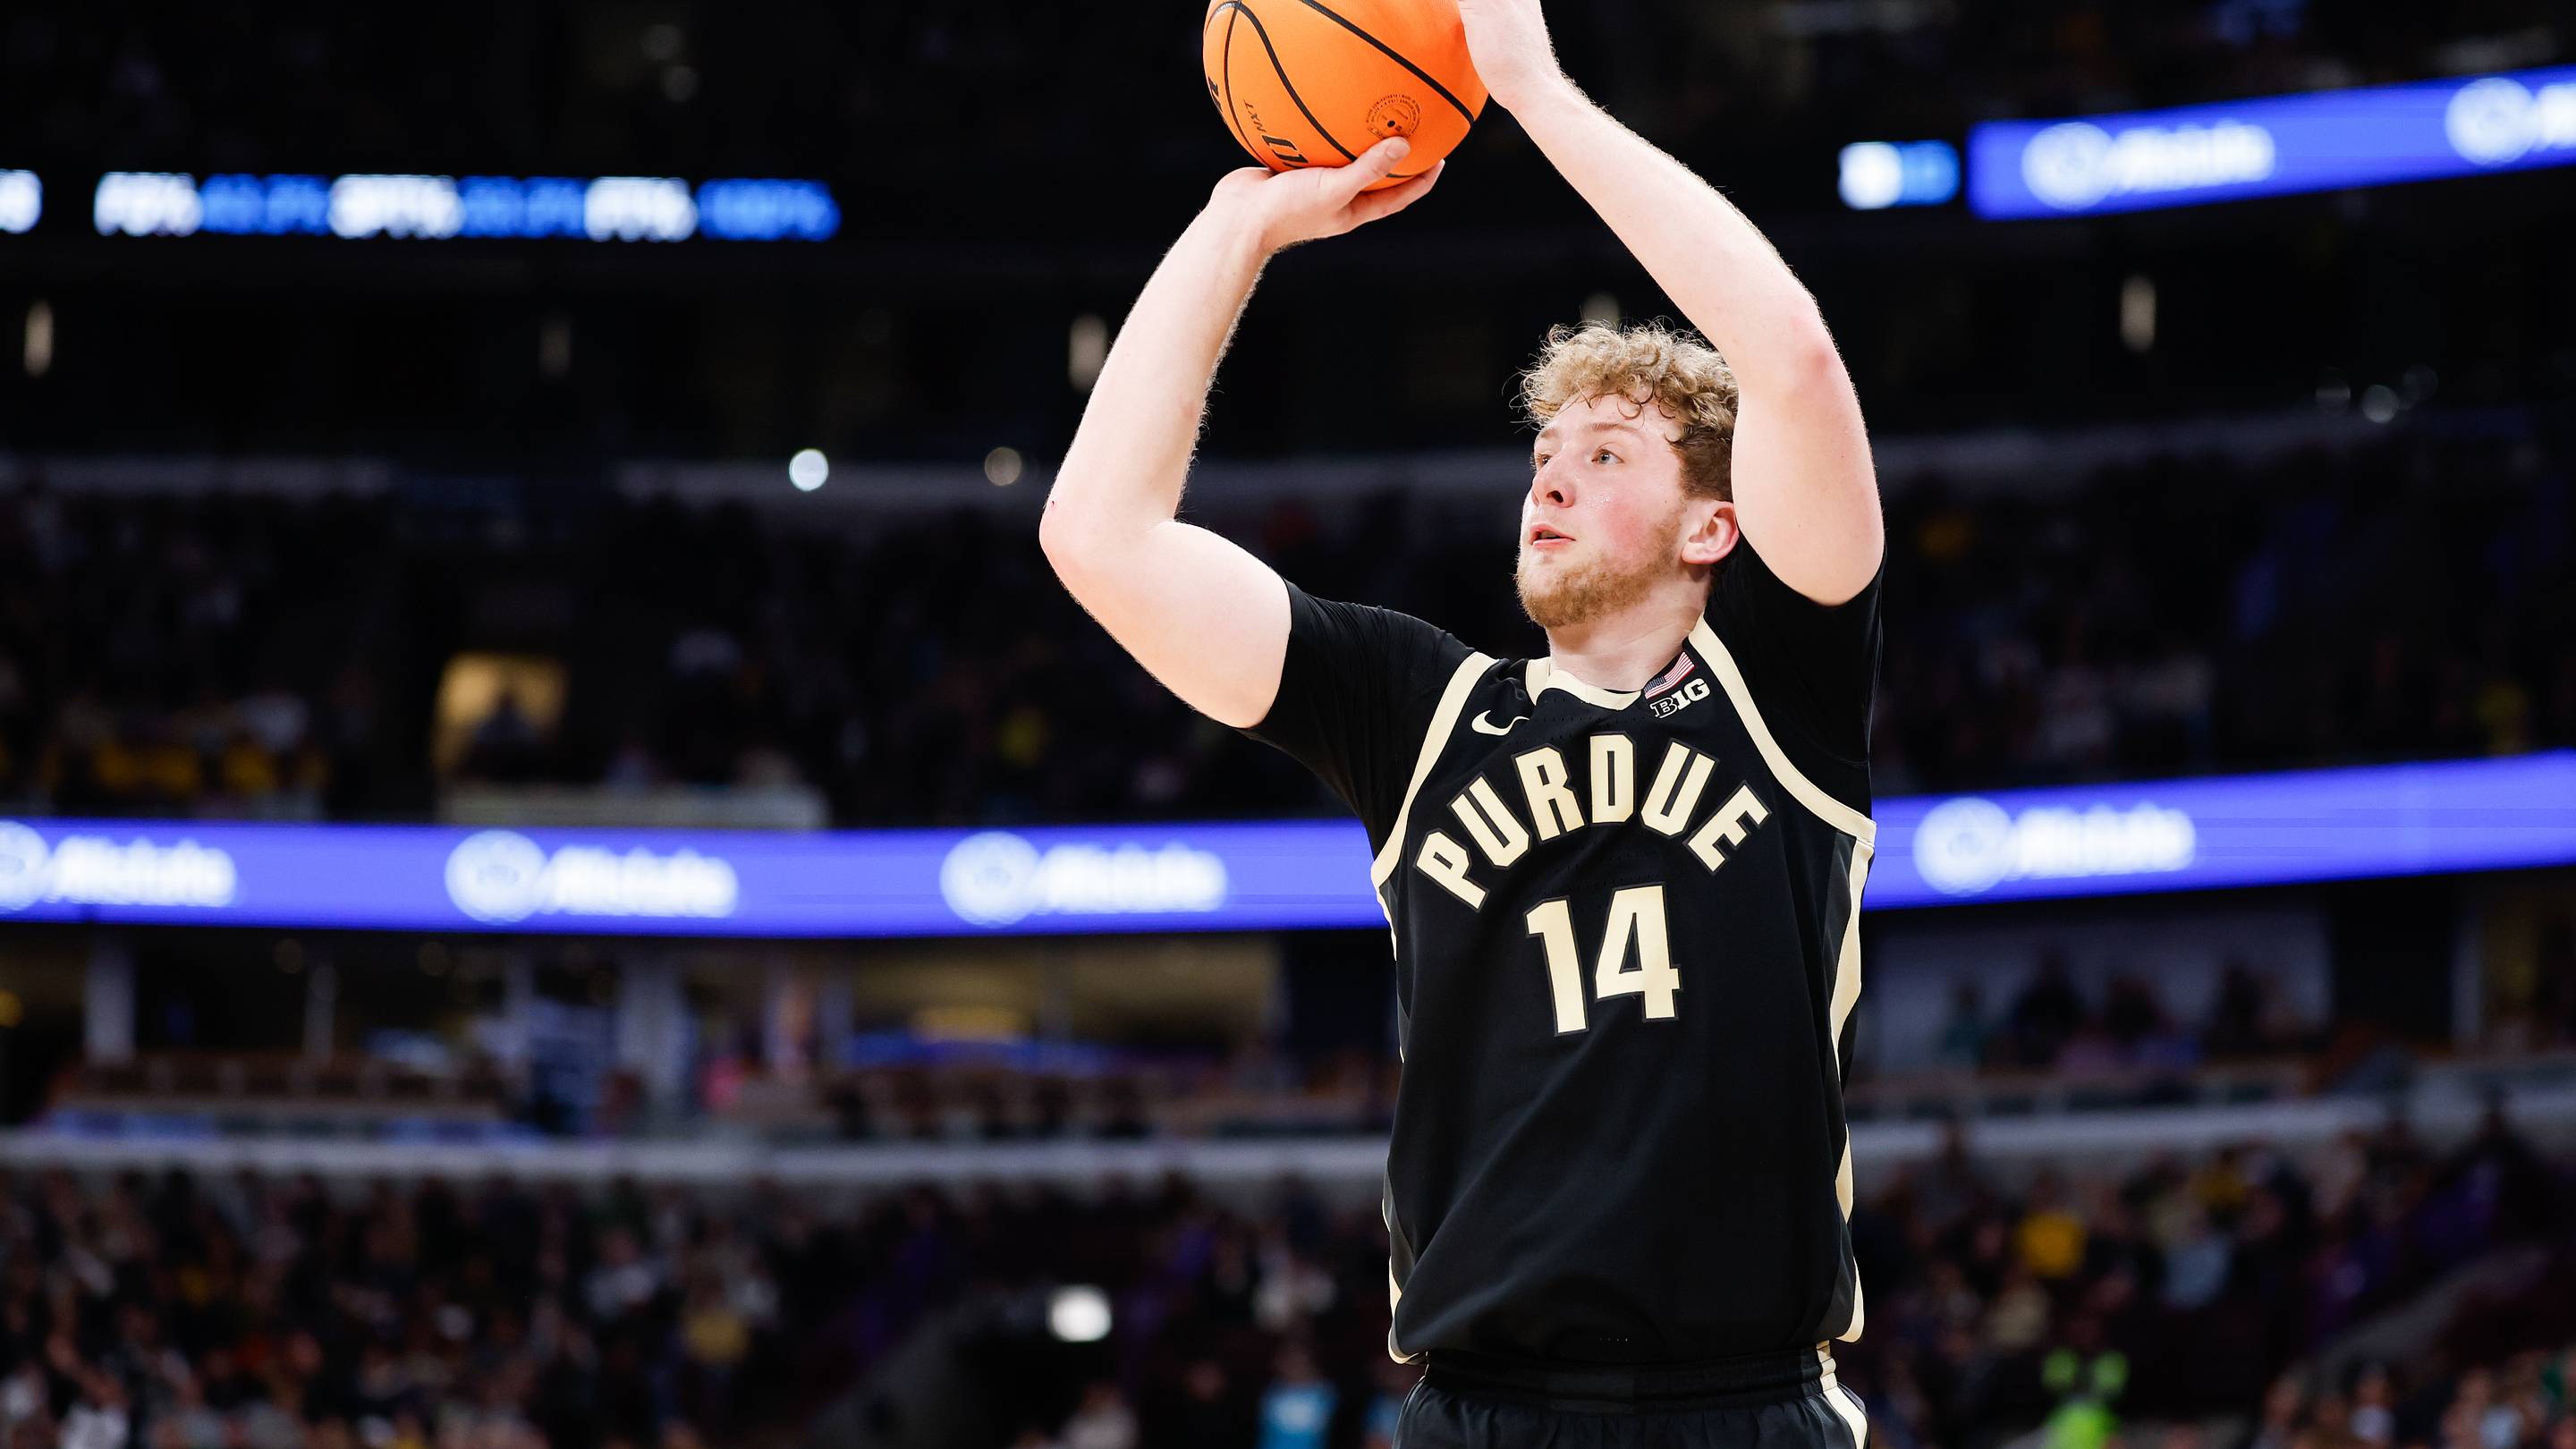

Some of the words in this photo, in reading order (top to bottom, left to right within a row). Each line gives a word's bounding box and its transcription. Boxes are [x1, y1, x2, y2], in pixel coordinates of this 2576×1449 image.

[1243, 99, 1267, 133] NXT
[1413, 730, 1772, 912] PURDUE
[1523, 881, 1683, 1038] 14
